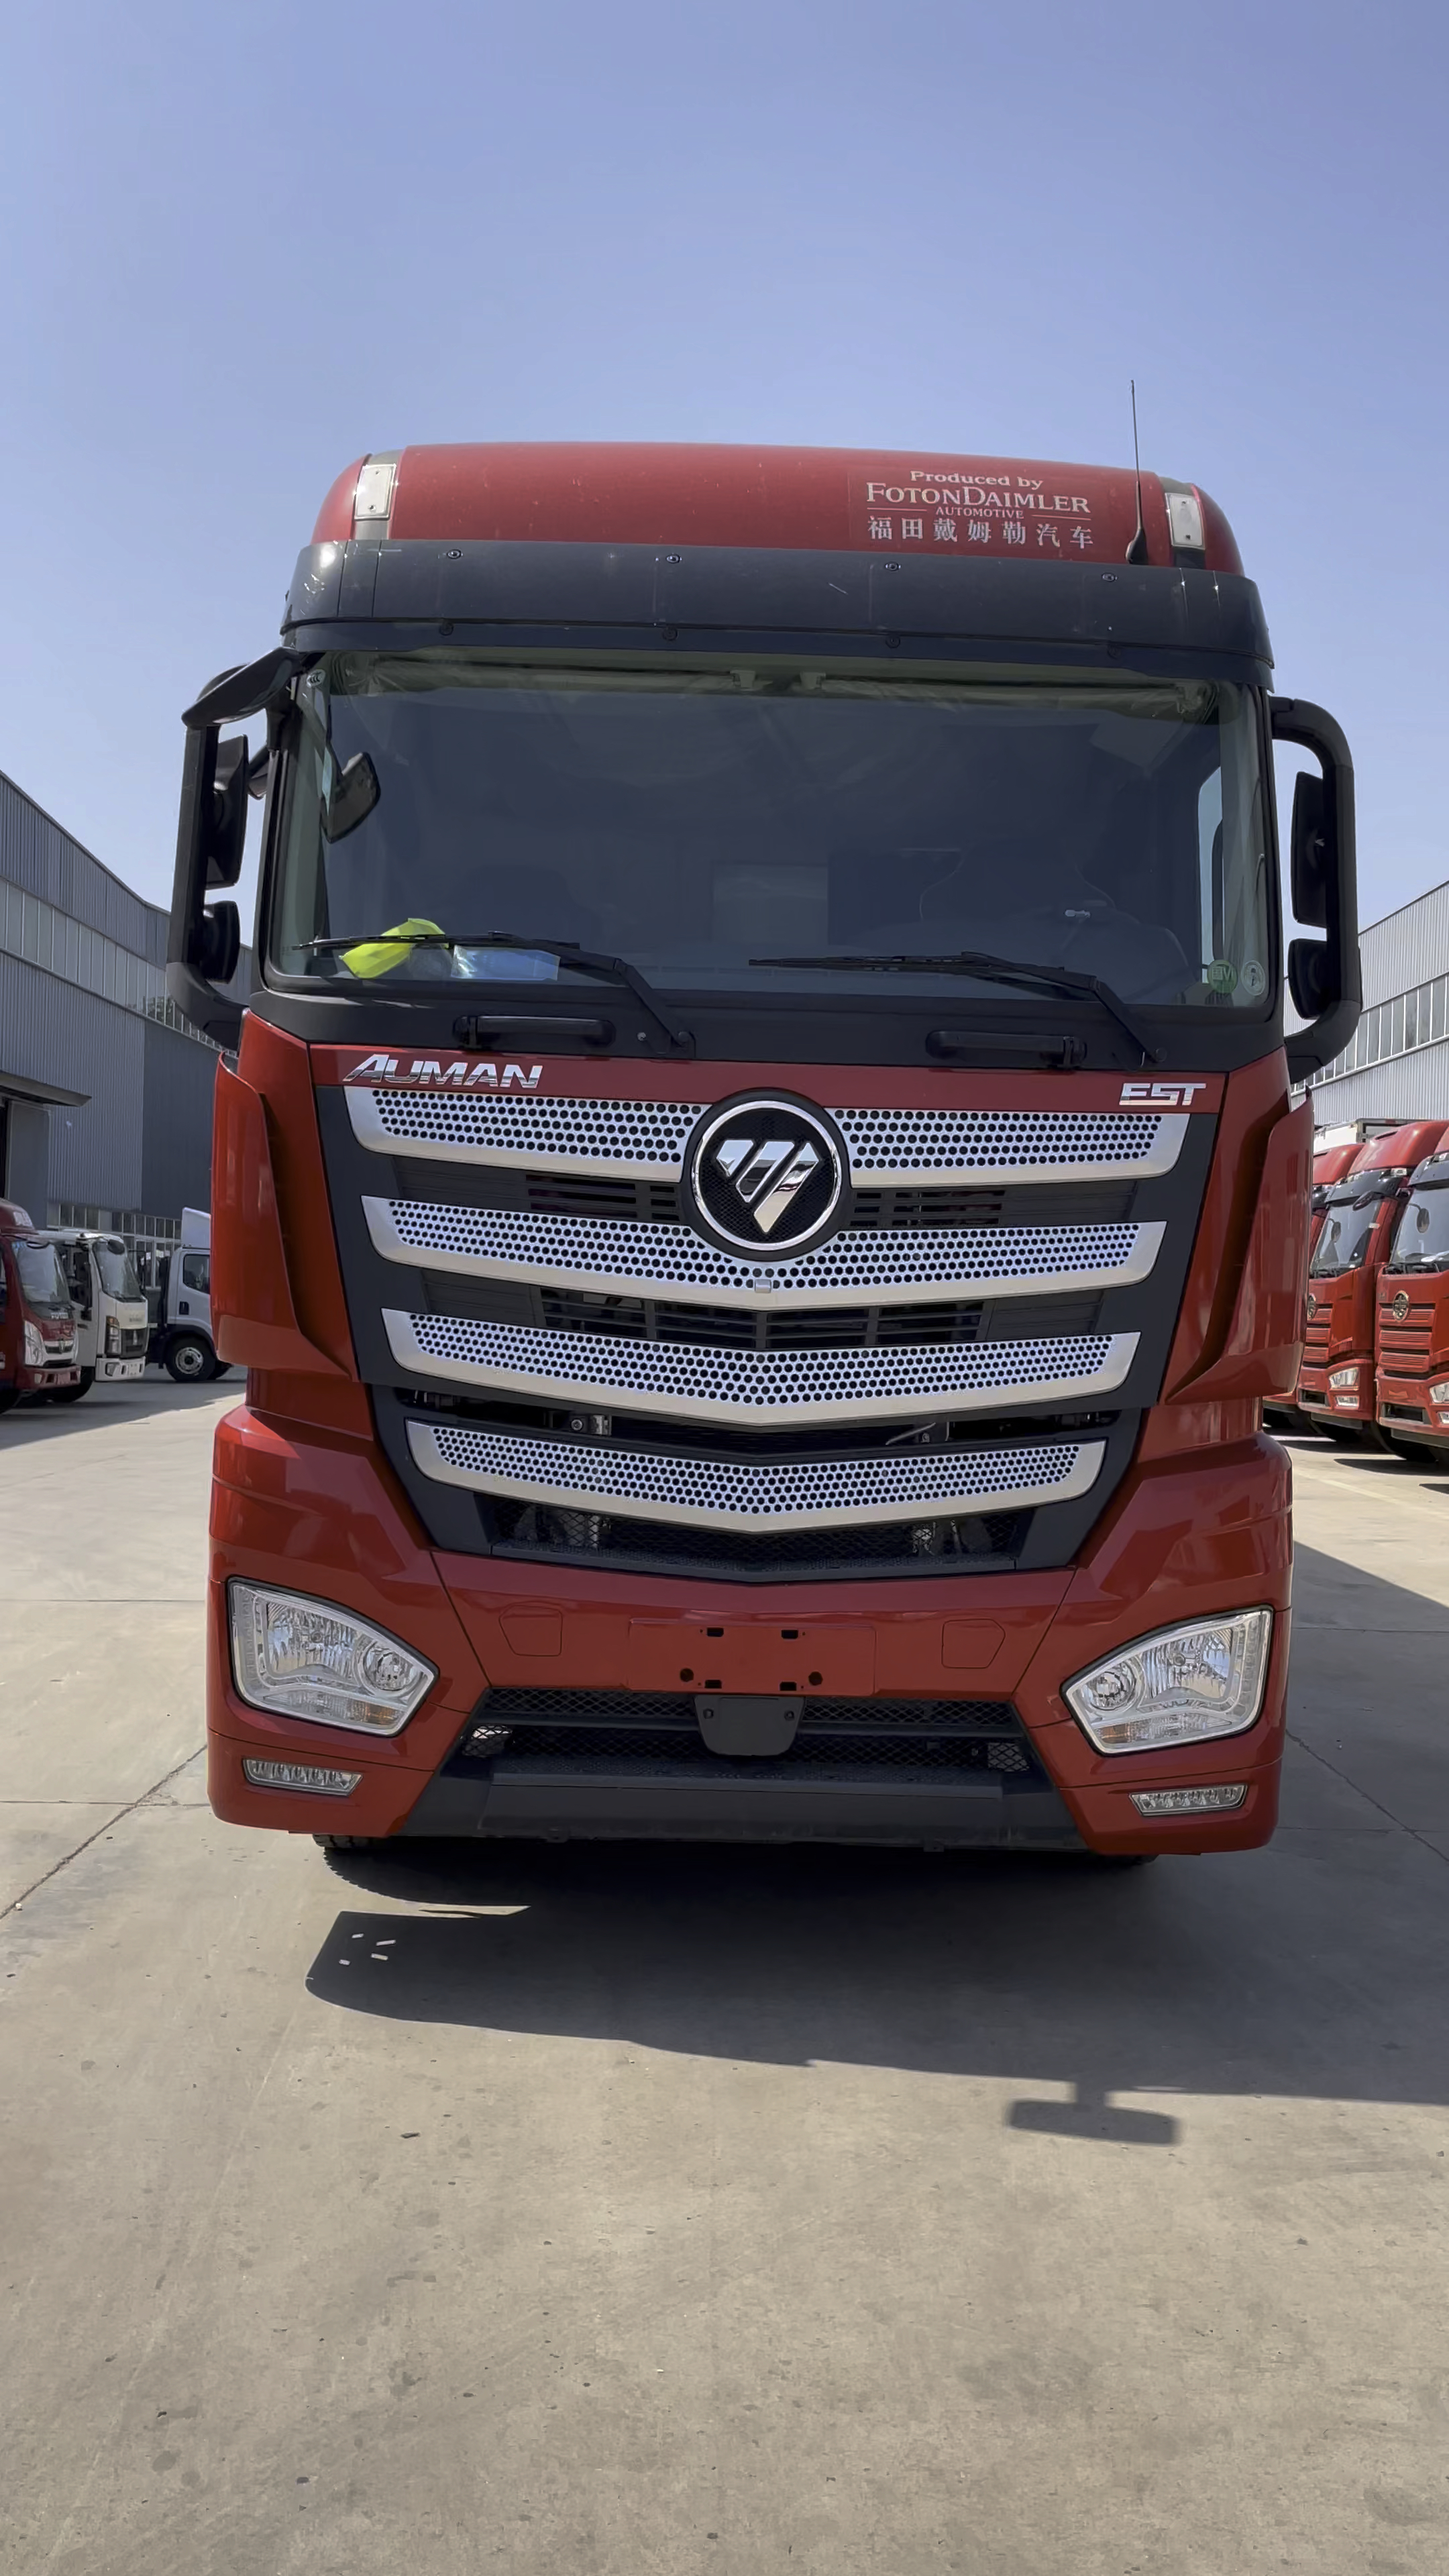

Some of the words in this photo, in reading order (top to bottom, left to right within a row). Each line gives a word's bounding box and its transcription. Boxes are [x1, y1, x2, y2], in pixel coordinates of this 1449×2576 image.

[910, 470, 1010, 487] Produced
[1017, 476, 1044, 490] by
[935, 506, 1024, 520] AUTOMOTIVE
[867, 515, 1093, 549] 福田戴姆勒汽车
[342, 1054, 543, 1088] AUMAN
[1119, 1083, 1206, 1106] EST
